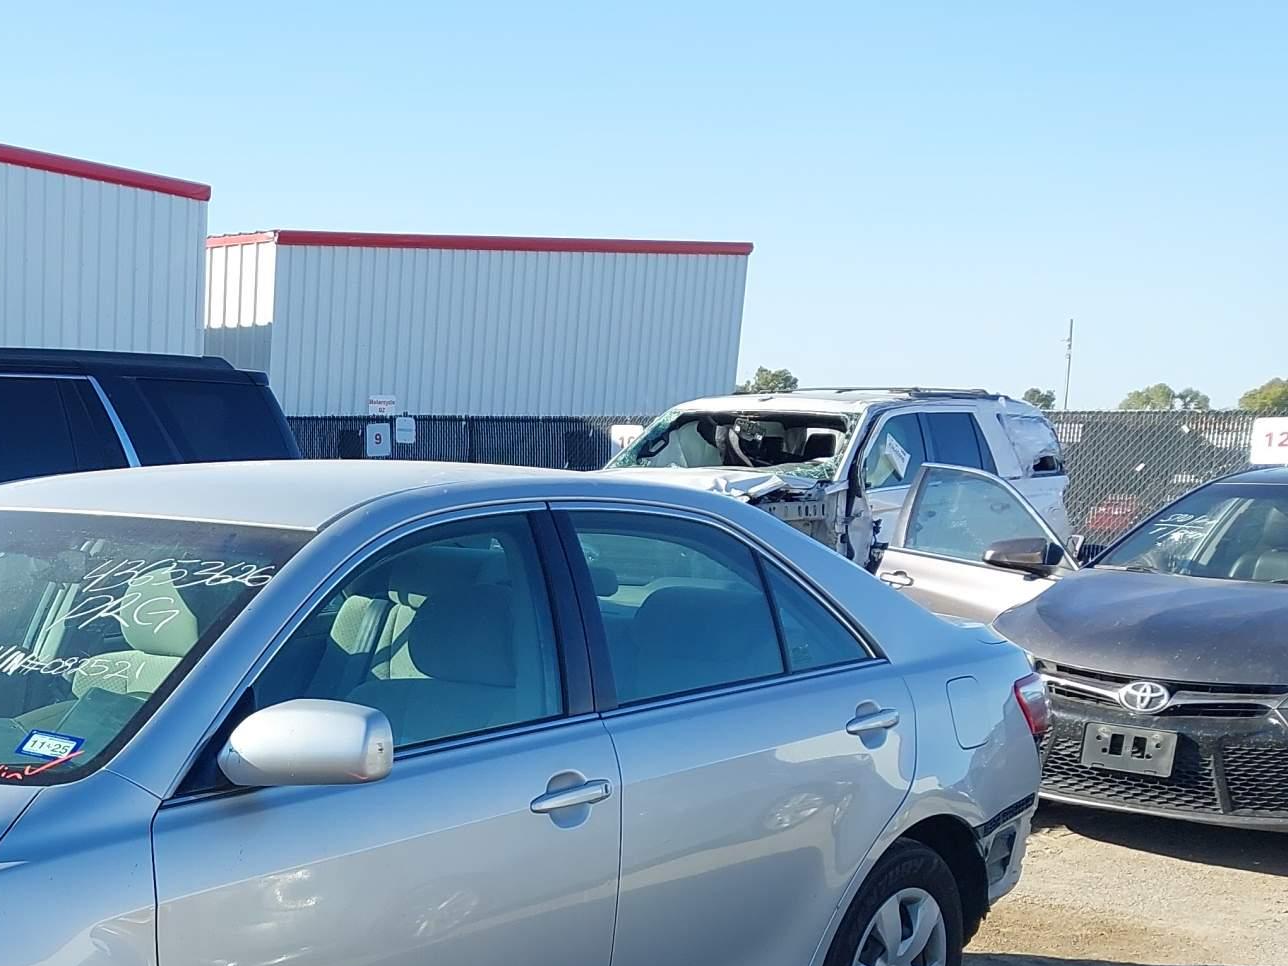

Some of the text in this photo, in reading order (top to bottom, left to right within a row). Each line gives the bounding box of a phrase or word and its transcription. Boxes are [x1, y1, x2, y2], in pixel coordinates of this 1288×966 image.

[374, 433, 382, 444] 9
[1265, 432, 1288, 447] 12
[83, 558, 275, 592] 43653626
